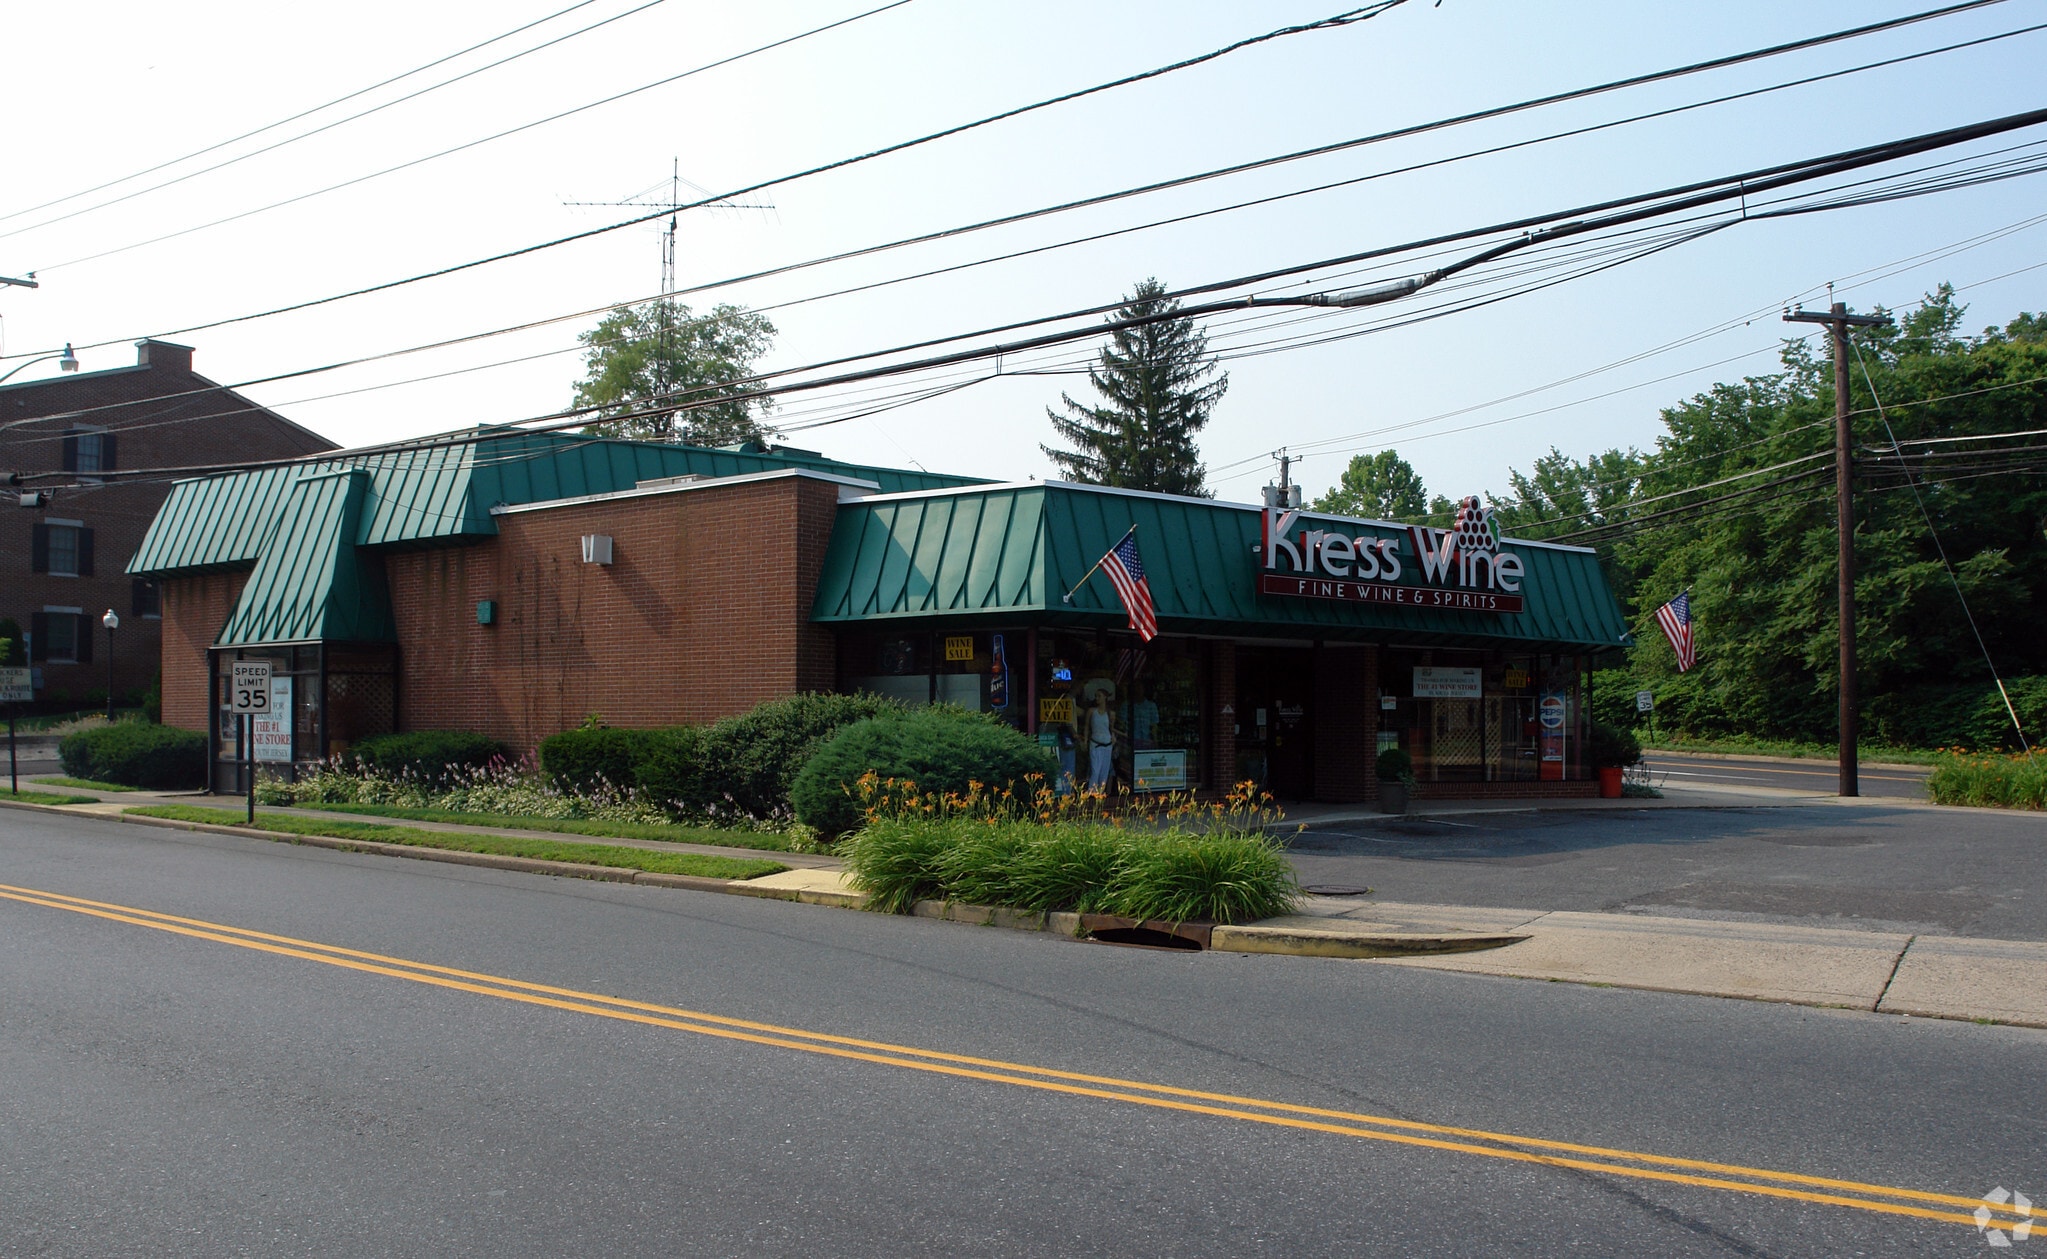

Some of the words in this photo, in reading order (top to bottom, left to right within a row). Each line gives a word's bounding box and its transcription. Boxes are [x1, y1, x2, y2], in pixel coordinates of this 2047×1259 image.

[1261, 508, 1401, 582] Kress
[1408, 527, 1525, 593] Wine
[1298, 580, 1345, 598] FINE
[1357, 585, 1404, 603] WINE
[1414, 591, 1424, 604] &
[1433, 592, 1496, 609] SPIRITS
[947, 638, 972, 648] WINE
[949, 649, 971, 659] SALE
[234, 667, 268, 676] SPEED
[237, 679, 264, 687] LIMIT
[237, 690, 267, 708] 35
[272, 702, 285, 710] FOR
[1042, 700, 1071, 710] WINE
[1640, 701, 1652, 709] 35
[1044, 711, 1069, 721] SALE
[1540, 708, 1563, 716] PEPSI
[255, 721, 270, 732] THE
[272, 721, 280, 732] #1
[265, 734, 291, 745] STORE
